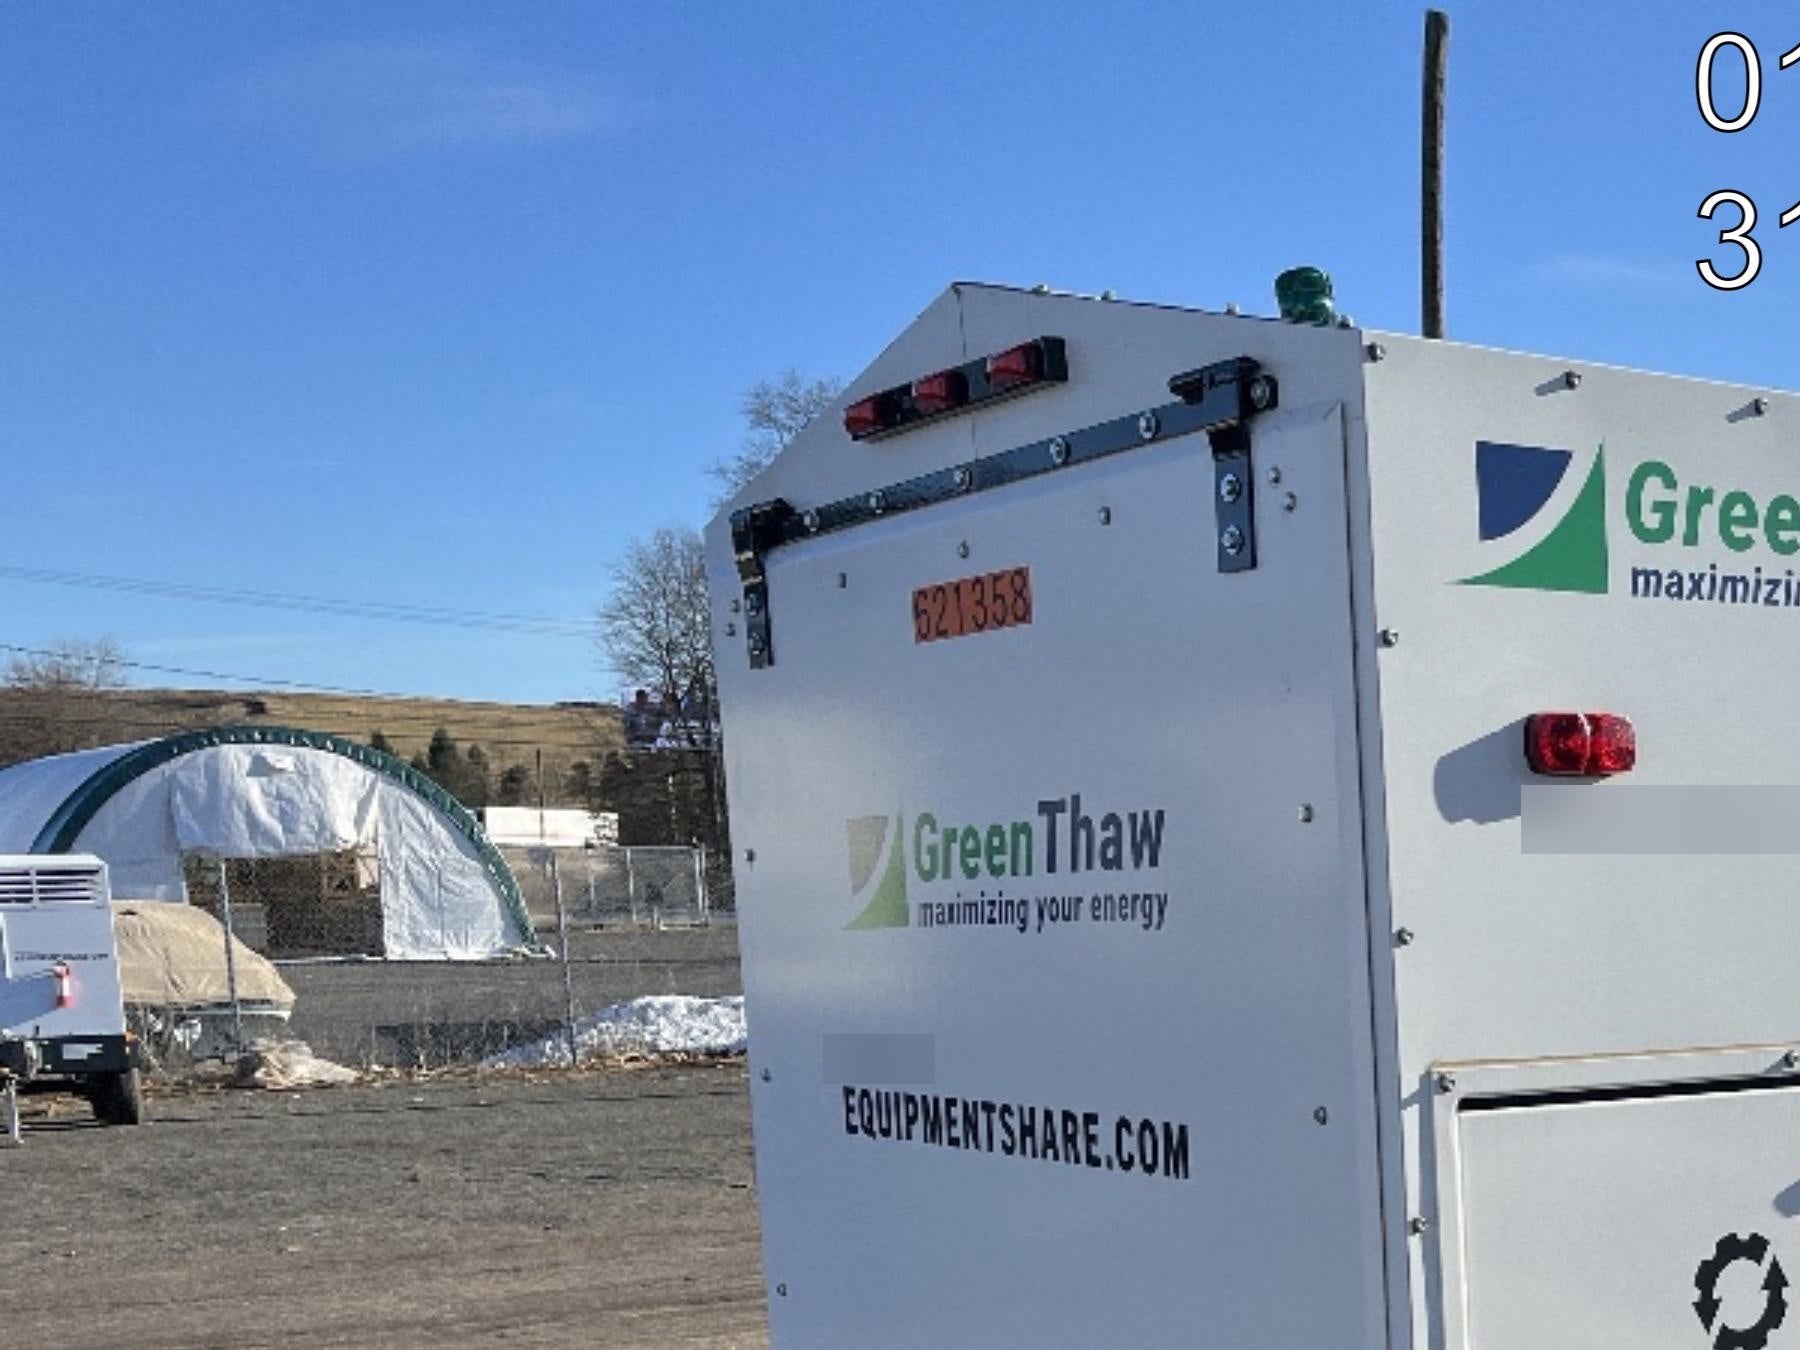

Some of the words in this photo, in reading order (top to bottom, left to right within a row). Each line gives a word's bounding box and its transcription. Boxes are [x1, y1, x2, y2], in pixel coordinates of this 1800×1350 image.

[914, 568, 1029, 641] 621358
[913, 793, 1165, 882] GreenThaw
[918, 890, 1030, 933] maximizing
[1036, 896, 1083, 933] your
[1091, 893, 1168, 930] energy
[842, 1085, 1190, 1180] EQUIPMENTSHARE.COM
